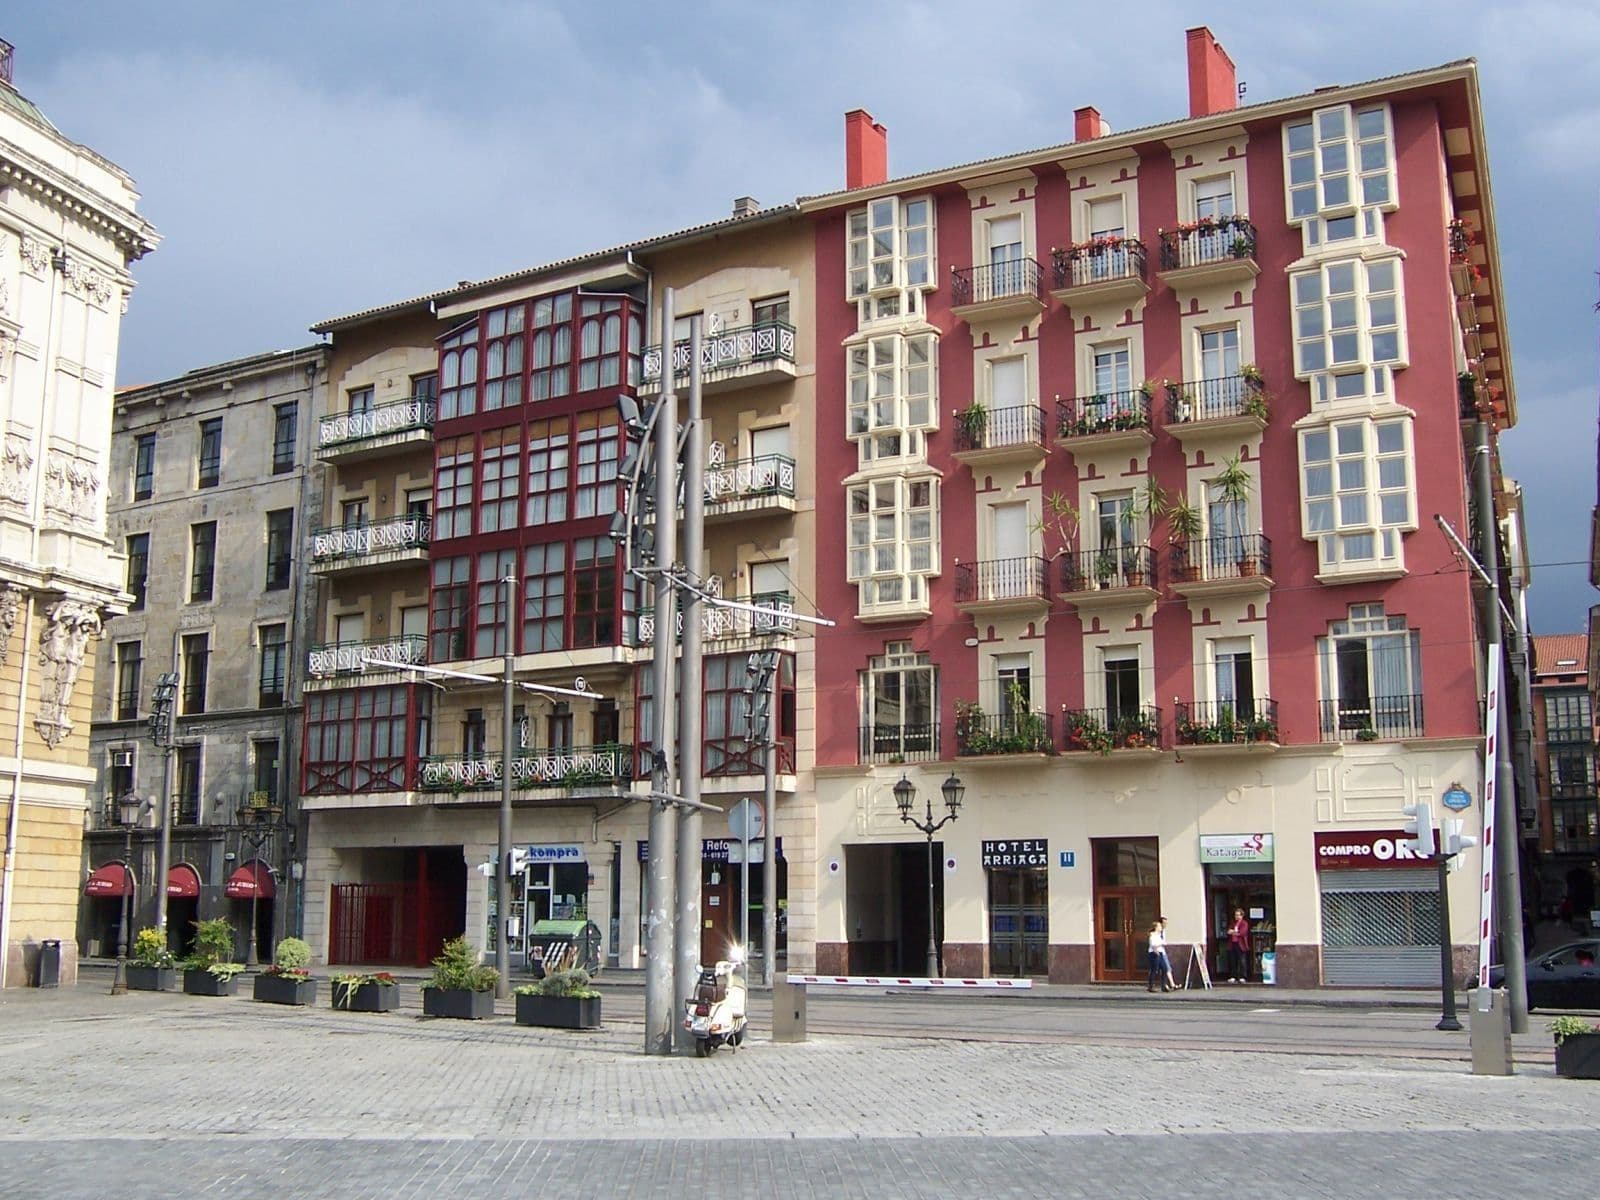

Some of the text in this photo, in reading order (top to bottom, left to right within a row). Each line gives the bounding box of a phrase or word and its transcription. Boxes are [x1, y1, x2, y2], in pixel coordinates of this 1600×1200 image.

[530, 846, 579, 858] kompra
[985, 841, 1044, 852] HOTEL
[1319, 845, 1371, 855] COMPRO
[983, 854, 1048, 865] ARRIAGA
